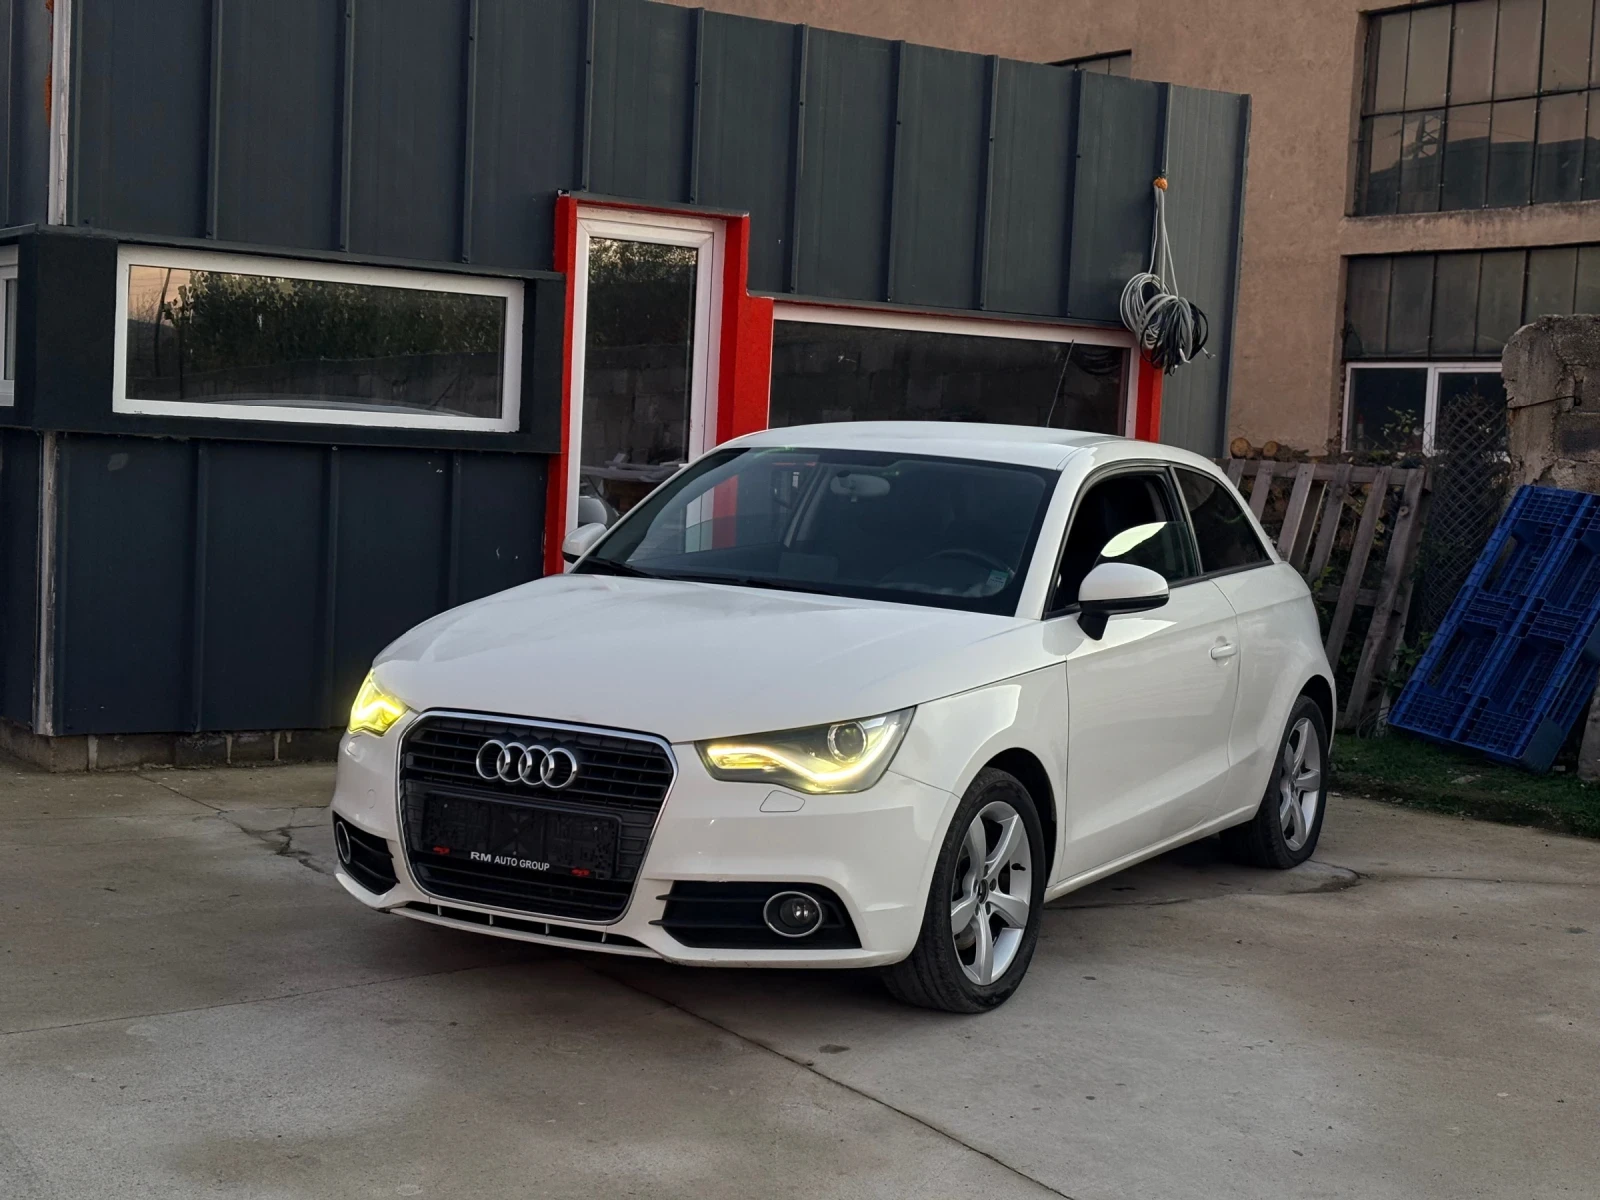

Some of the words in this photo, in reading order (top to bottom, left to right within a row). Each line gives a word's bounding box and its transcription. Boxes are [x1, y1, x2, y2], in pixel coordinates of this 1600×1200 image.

[470, 851, 492, 863] RM
[494, 855, 518, 867] AUTO
[519, 859, 550, 871] GROUP
